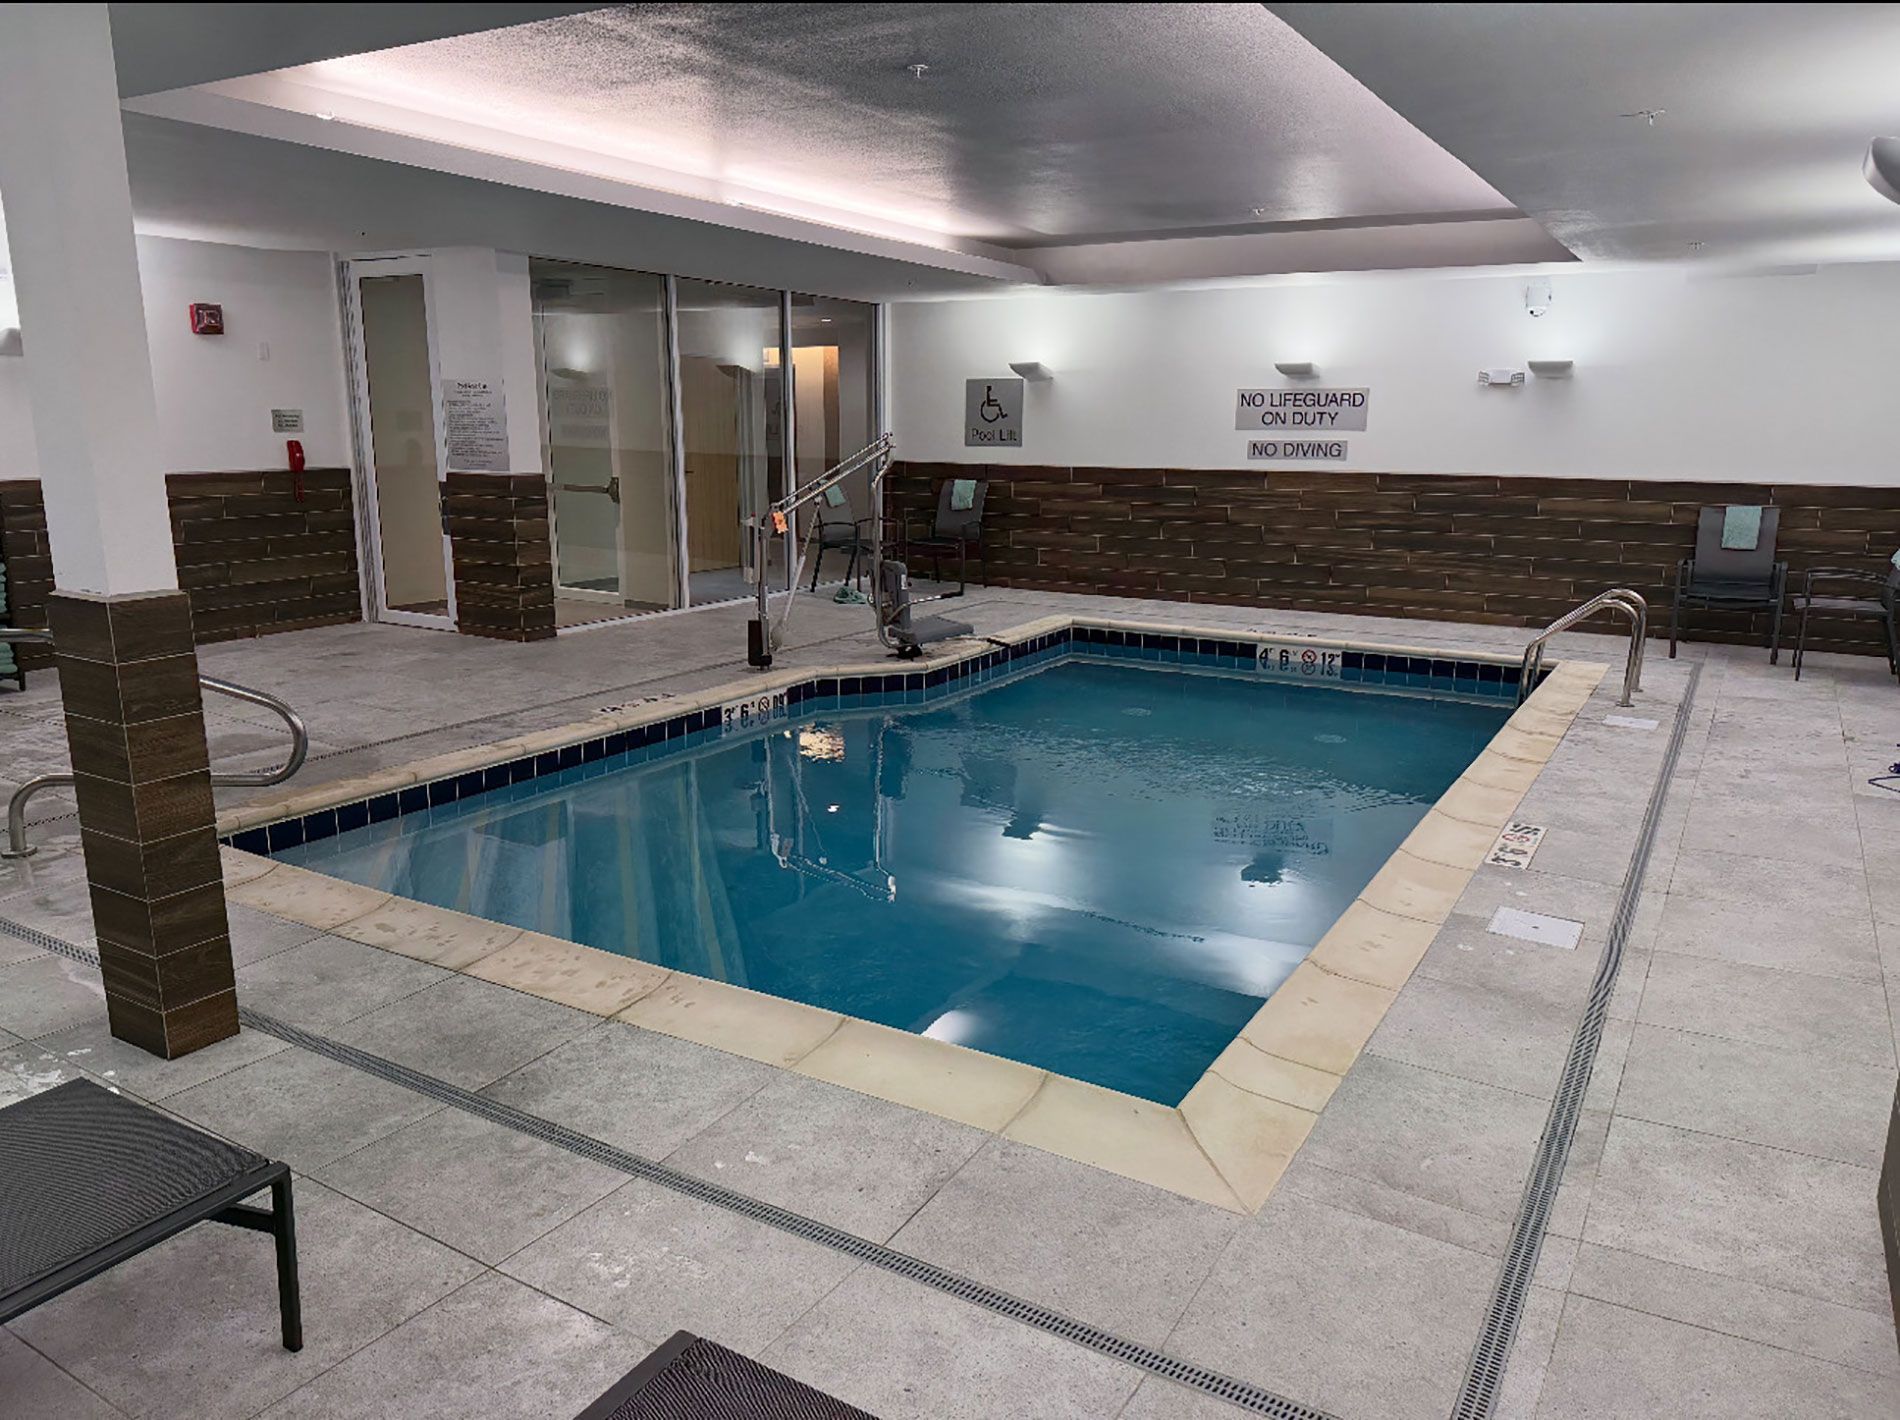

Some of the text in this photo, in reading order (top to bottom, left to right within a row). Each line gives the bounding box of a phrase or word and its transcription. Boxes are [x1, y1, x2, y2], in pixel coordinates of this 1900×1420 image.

[1240, 393, 1365, 407] NO LIFEGUARD
[1261, 411, 1338, 425] ON DUTY
[971, 428, 995, 441] Pool
[1252, 443, 1342, 457] NO DIVING
